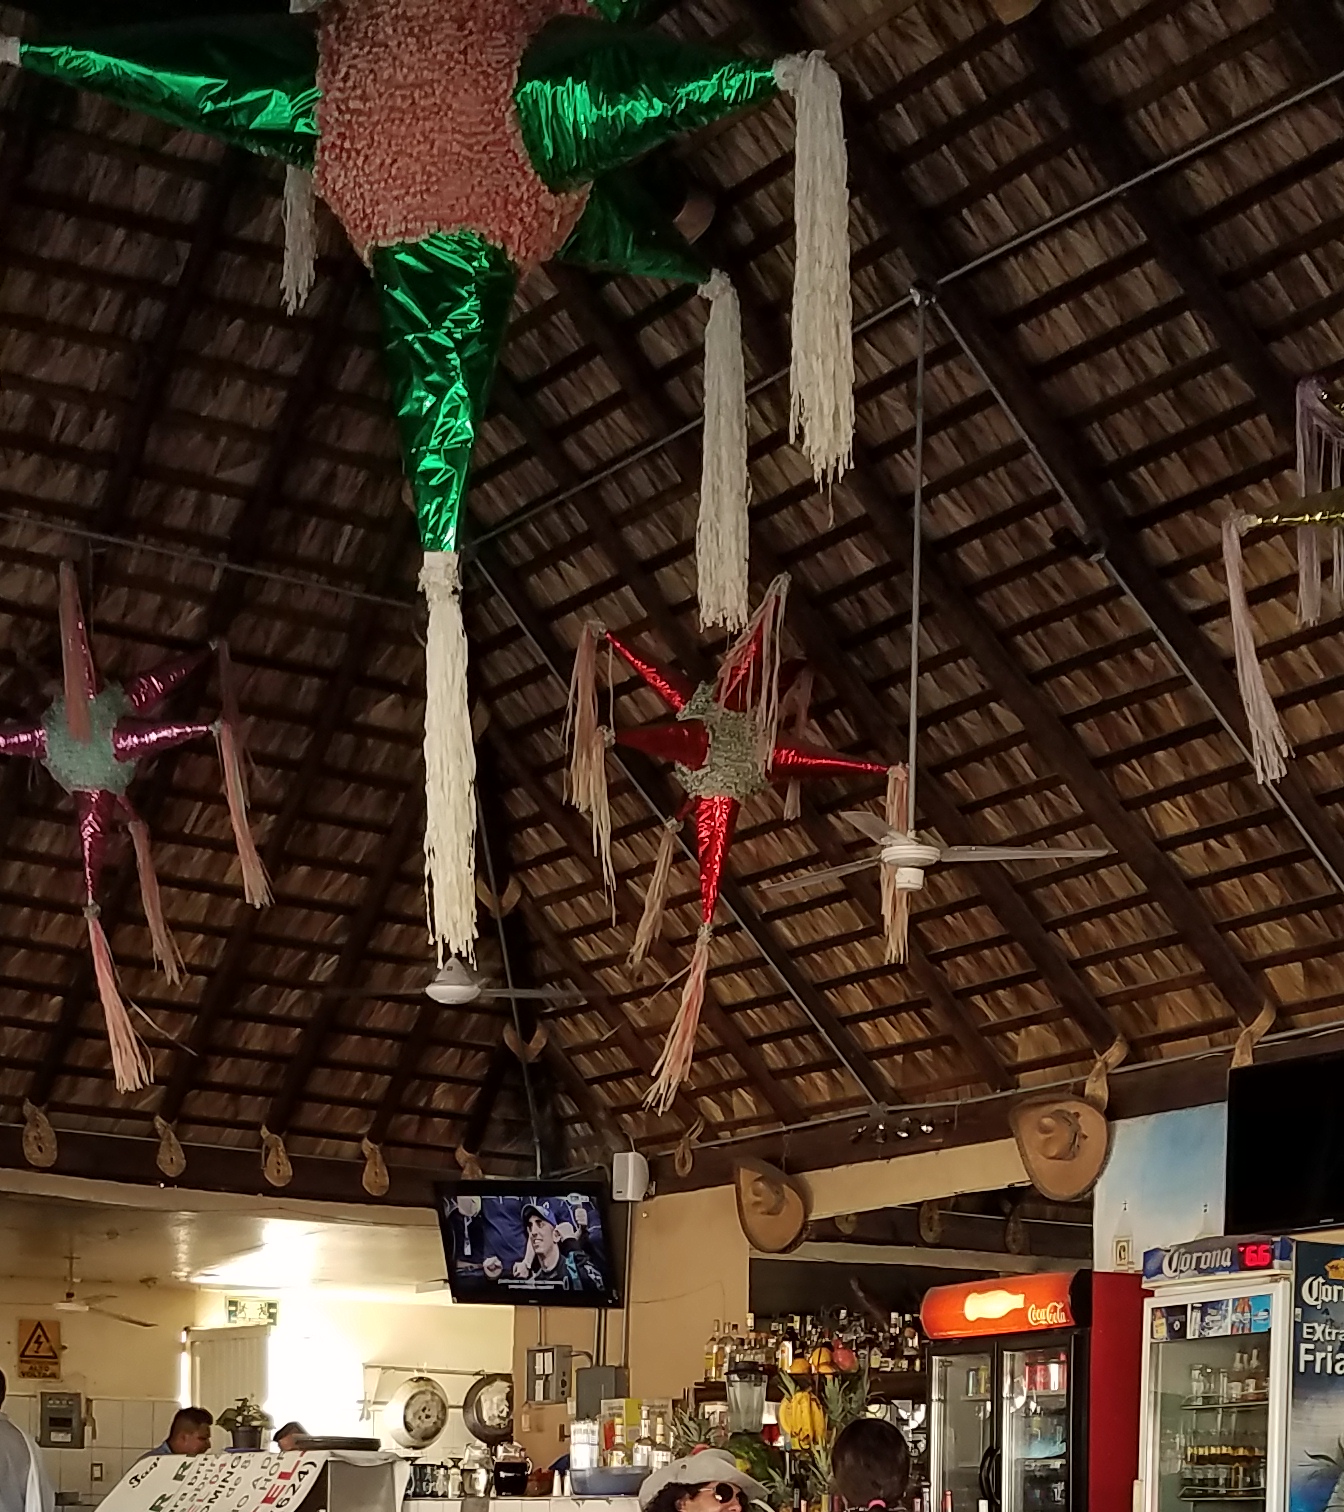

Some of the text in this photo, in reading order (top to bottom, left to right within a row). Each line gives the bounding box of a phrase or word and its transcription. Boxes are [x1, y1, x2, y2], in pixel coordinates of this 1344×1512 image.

[1162, 1246, 1233, 1280] Corona
[1027, 1301, 1067, 1326] Coca-Cola
[226, 1476, 242, 1498] de
